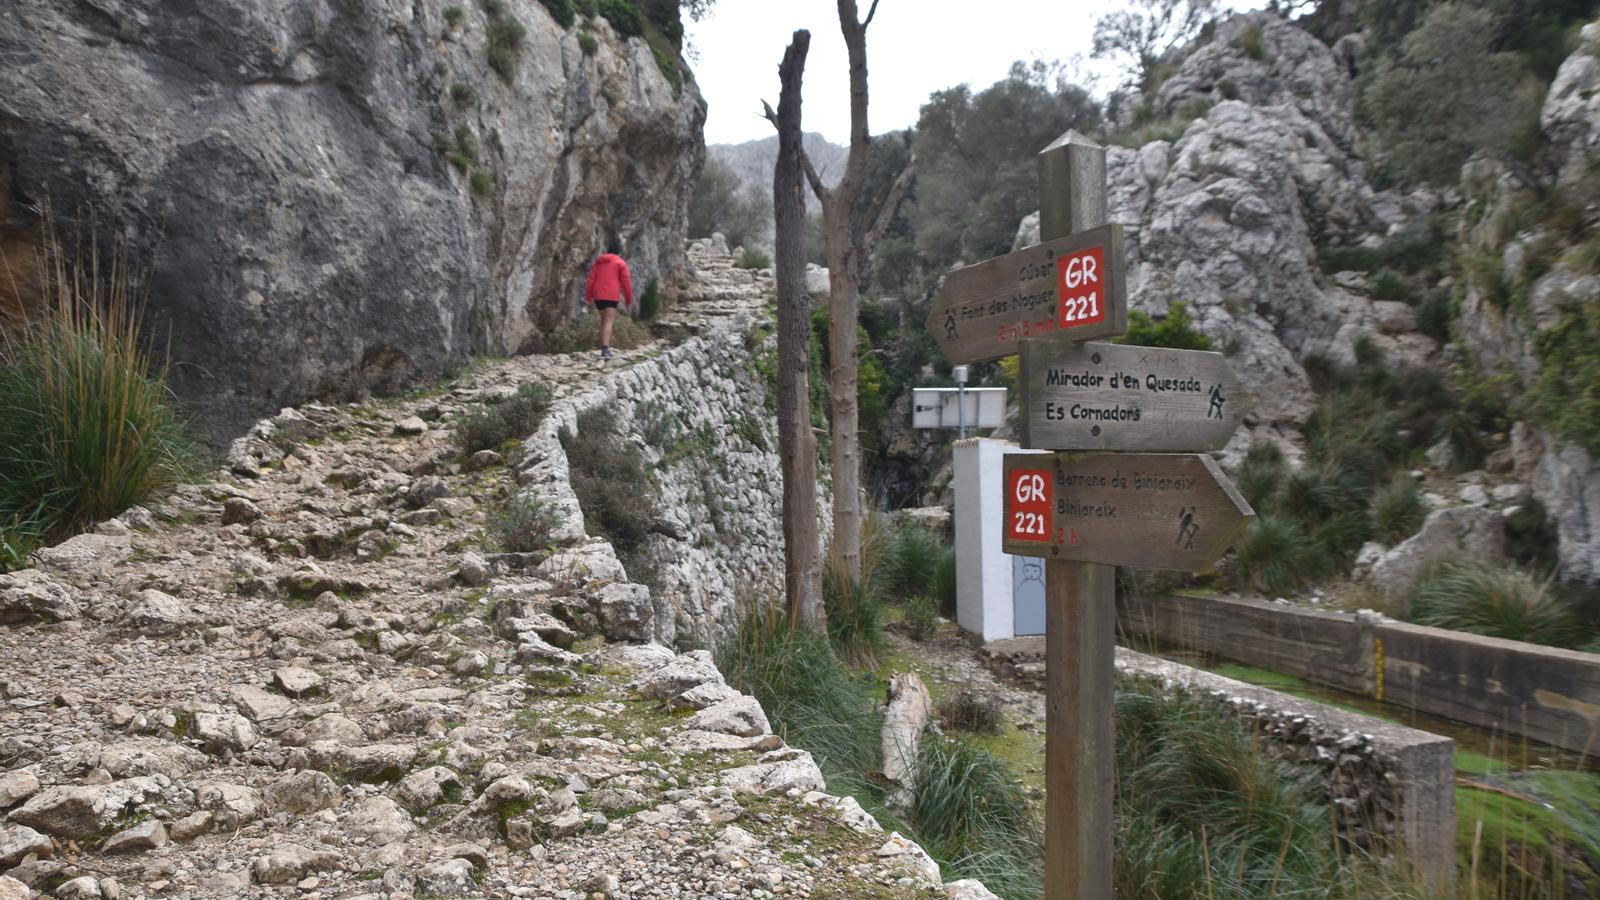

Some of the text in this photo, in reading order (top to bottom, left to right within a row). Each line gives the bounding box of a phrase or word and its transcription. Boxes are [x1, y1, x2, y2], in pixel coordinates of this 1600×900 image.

[1065, 255, 1098, 289] GR
[961, 305, 985, 321] Font
[988, 299, 1008, 315] des
[1065, 291, 1099, 322] 221
[1046, 369, 1201, 393] Mirador d'en Quesada
[1046, 402, 1141, 422] Es Cornadors
[1016, 474, 1046, 503] GR
[1111, 470, 1128, 489] de
[1015, 511, 1045, 535] 221
[1056, 527, 1066, 544] 2
